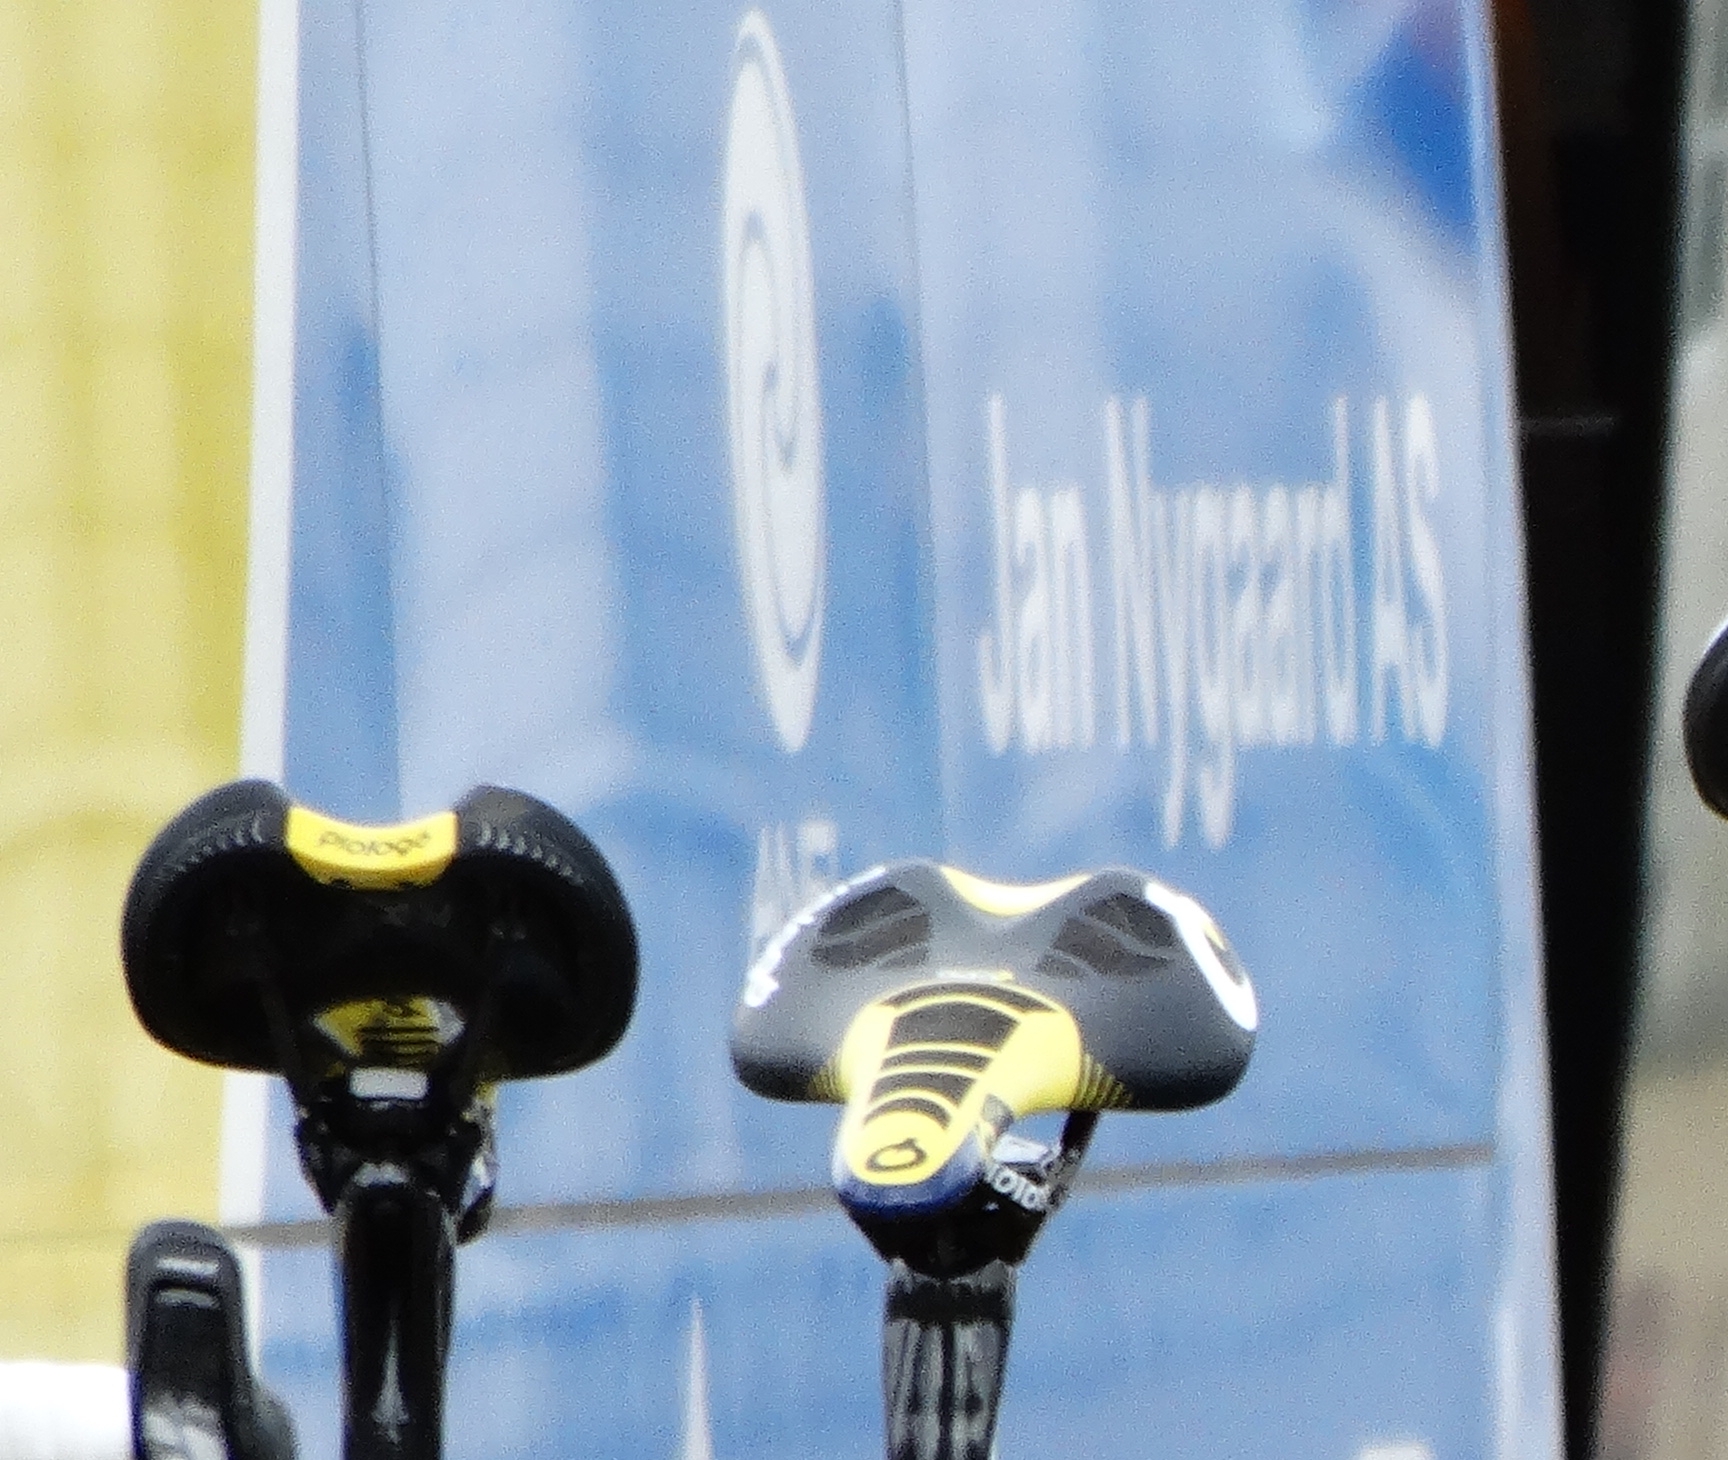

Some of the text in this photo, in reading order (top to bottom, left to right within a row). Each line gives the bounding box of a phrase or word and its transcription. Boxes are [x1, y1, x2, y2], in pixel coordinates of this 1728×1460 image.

[977, 393, 1449, 852] Jan Nygaard AS
